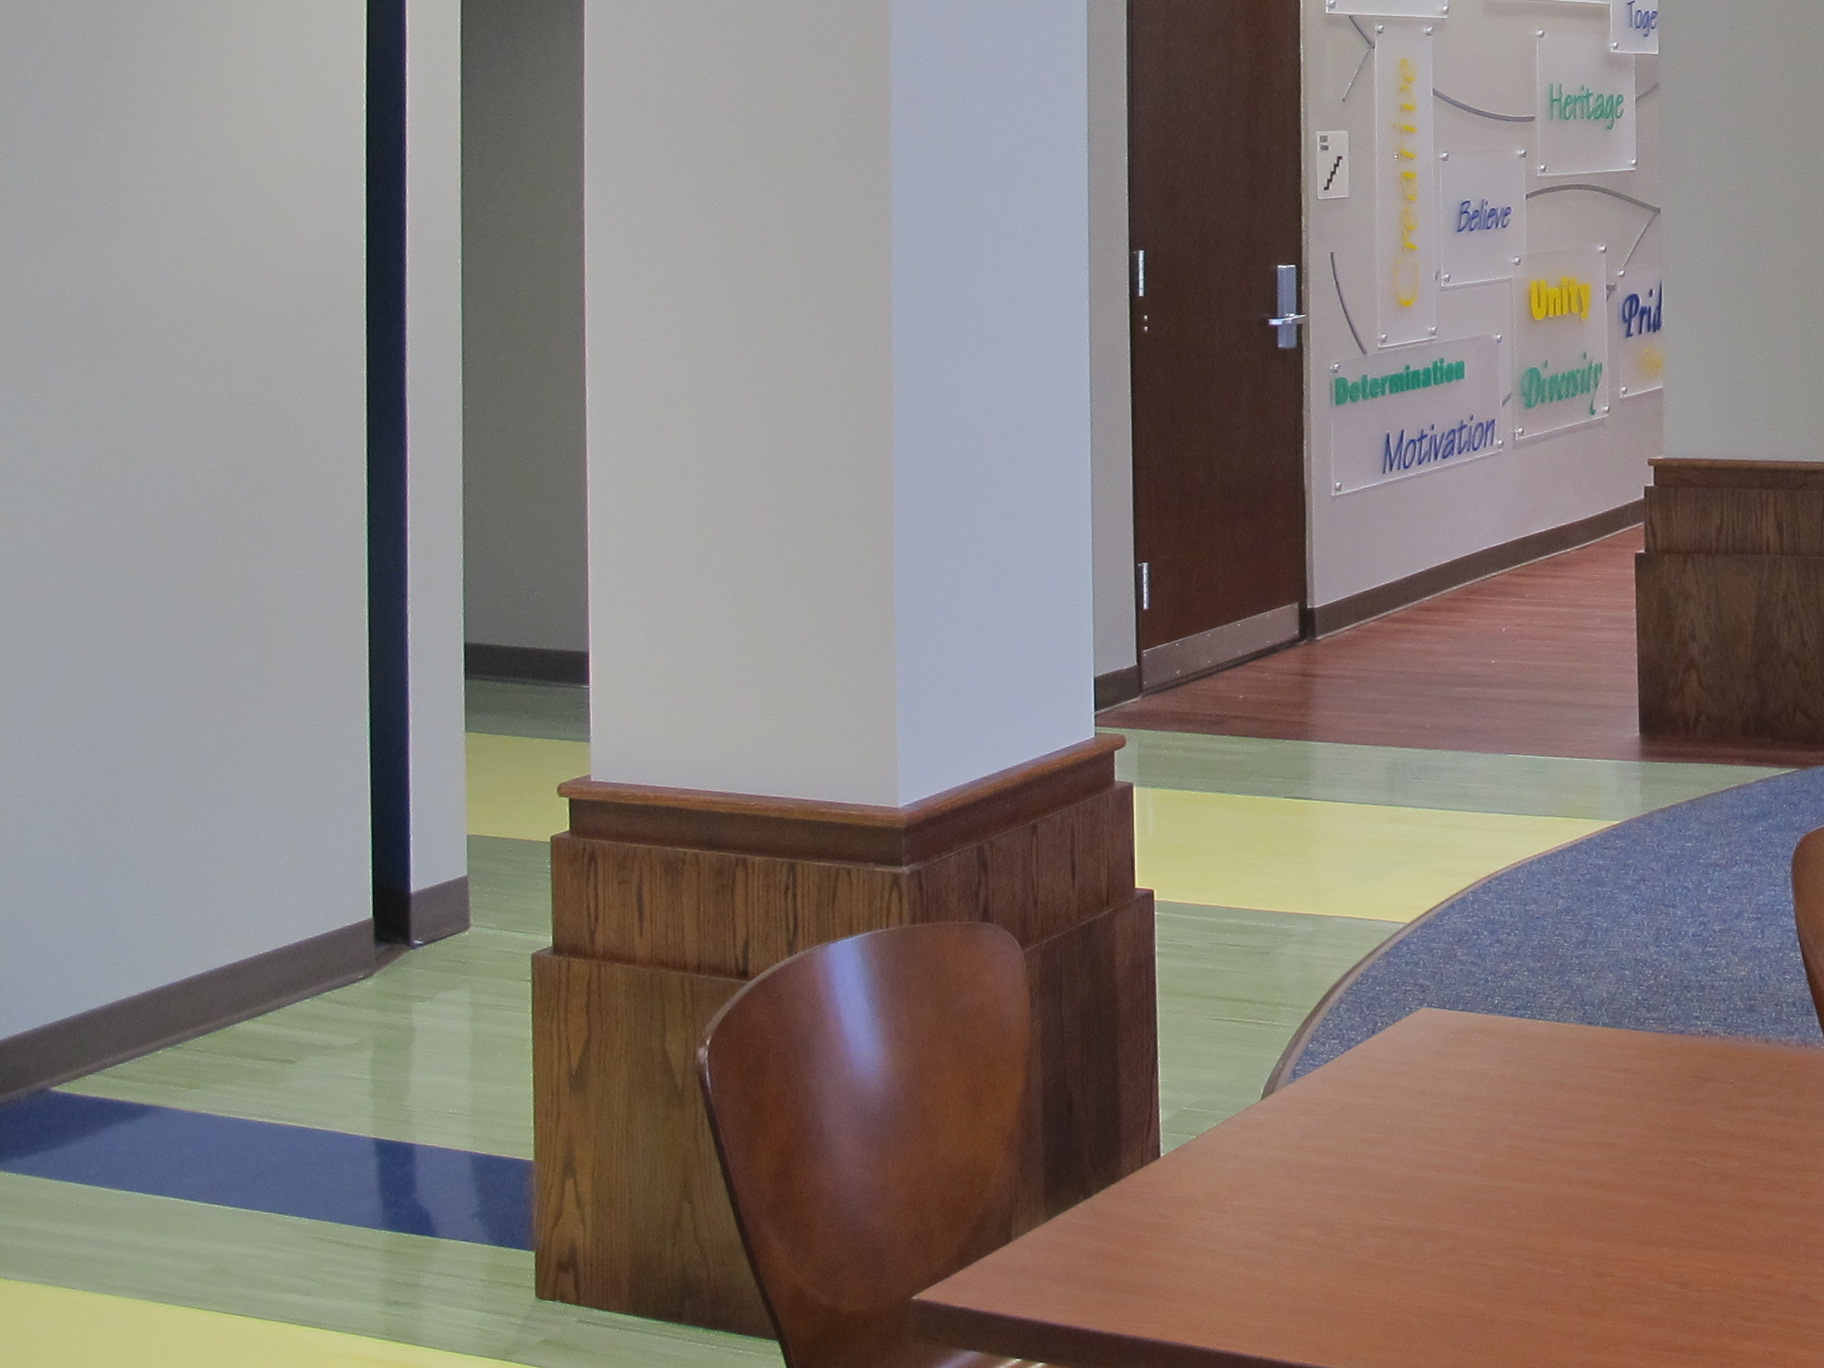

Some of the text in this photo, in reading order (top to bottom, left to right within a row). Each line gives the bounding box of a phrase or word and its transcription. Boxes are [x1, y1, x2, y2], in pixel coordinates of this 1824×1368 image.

[1548, 83, 1624, 130] Heritage
[1457, 199, 1512, 232] Believe
[1530, 276, 1591, 321] Unity
[1334, 357, 1466, 406] Determination
[1382, 415, 1496, 474] Motivation
